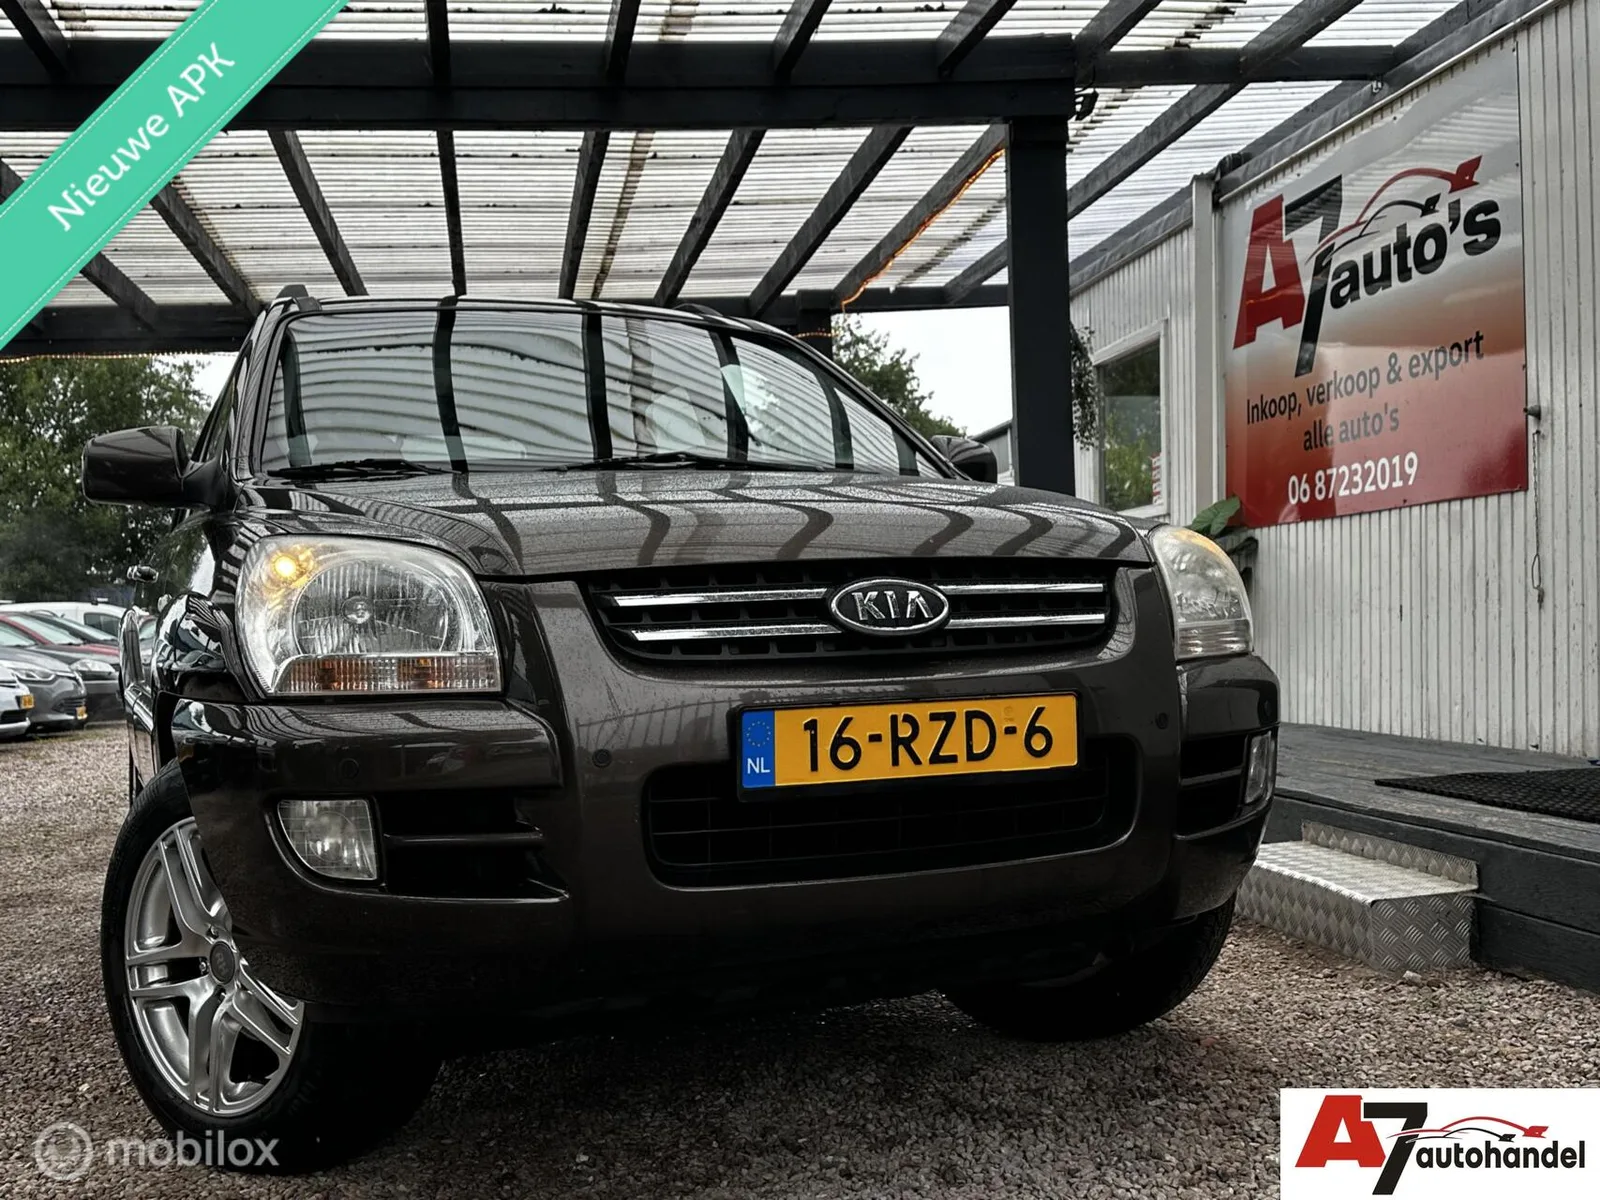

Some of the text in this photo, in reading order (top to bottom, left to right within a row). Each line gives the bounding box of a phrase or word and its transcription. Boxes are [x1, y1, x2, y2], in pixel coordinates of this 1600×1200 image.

[1233, 174, 1502, 378] A7 auto's
[1246, 330, 1485, 425] Inkoop, verkoop & export
[1303, 402, 1400, 451] alle auto's
[1287, 451, 1419, 505] 06 87232019
[851, 590, 934, 621] KIA
[746, 706, 1054, 775] NL 16-RZD-6
